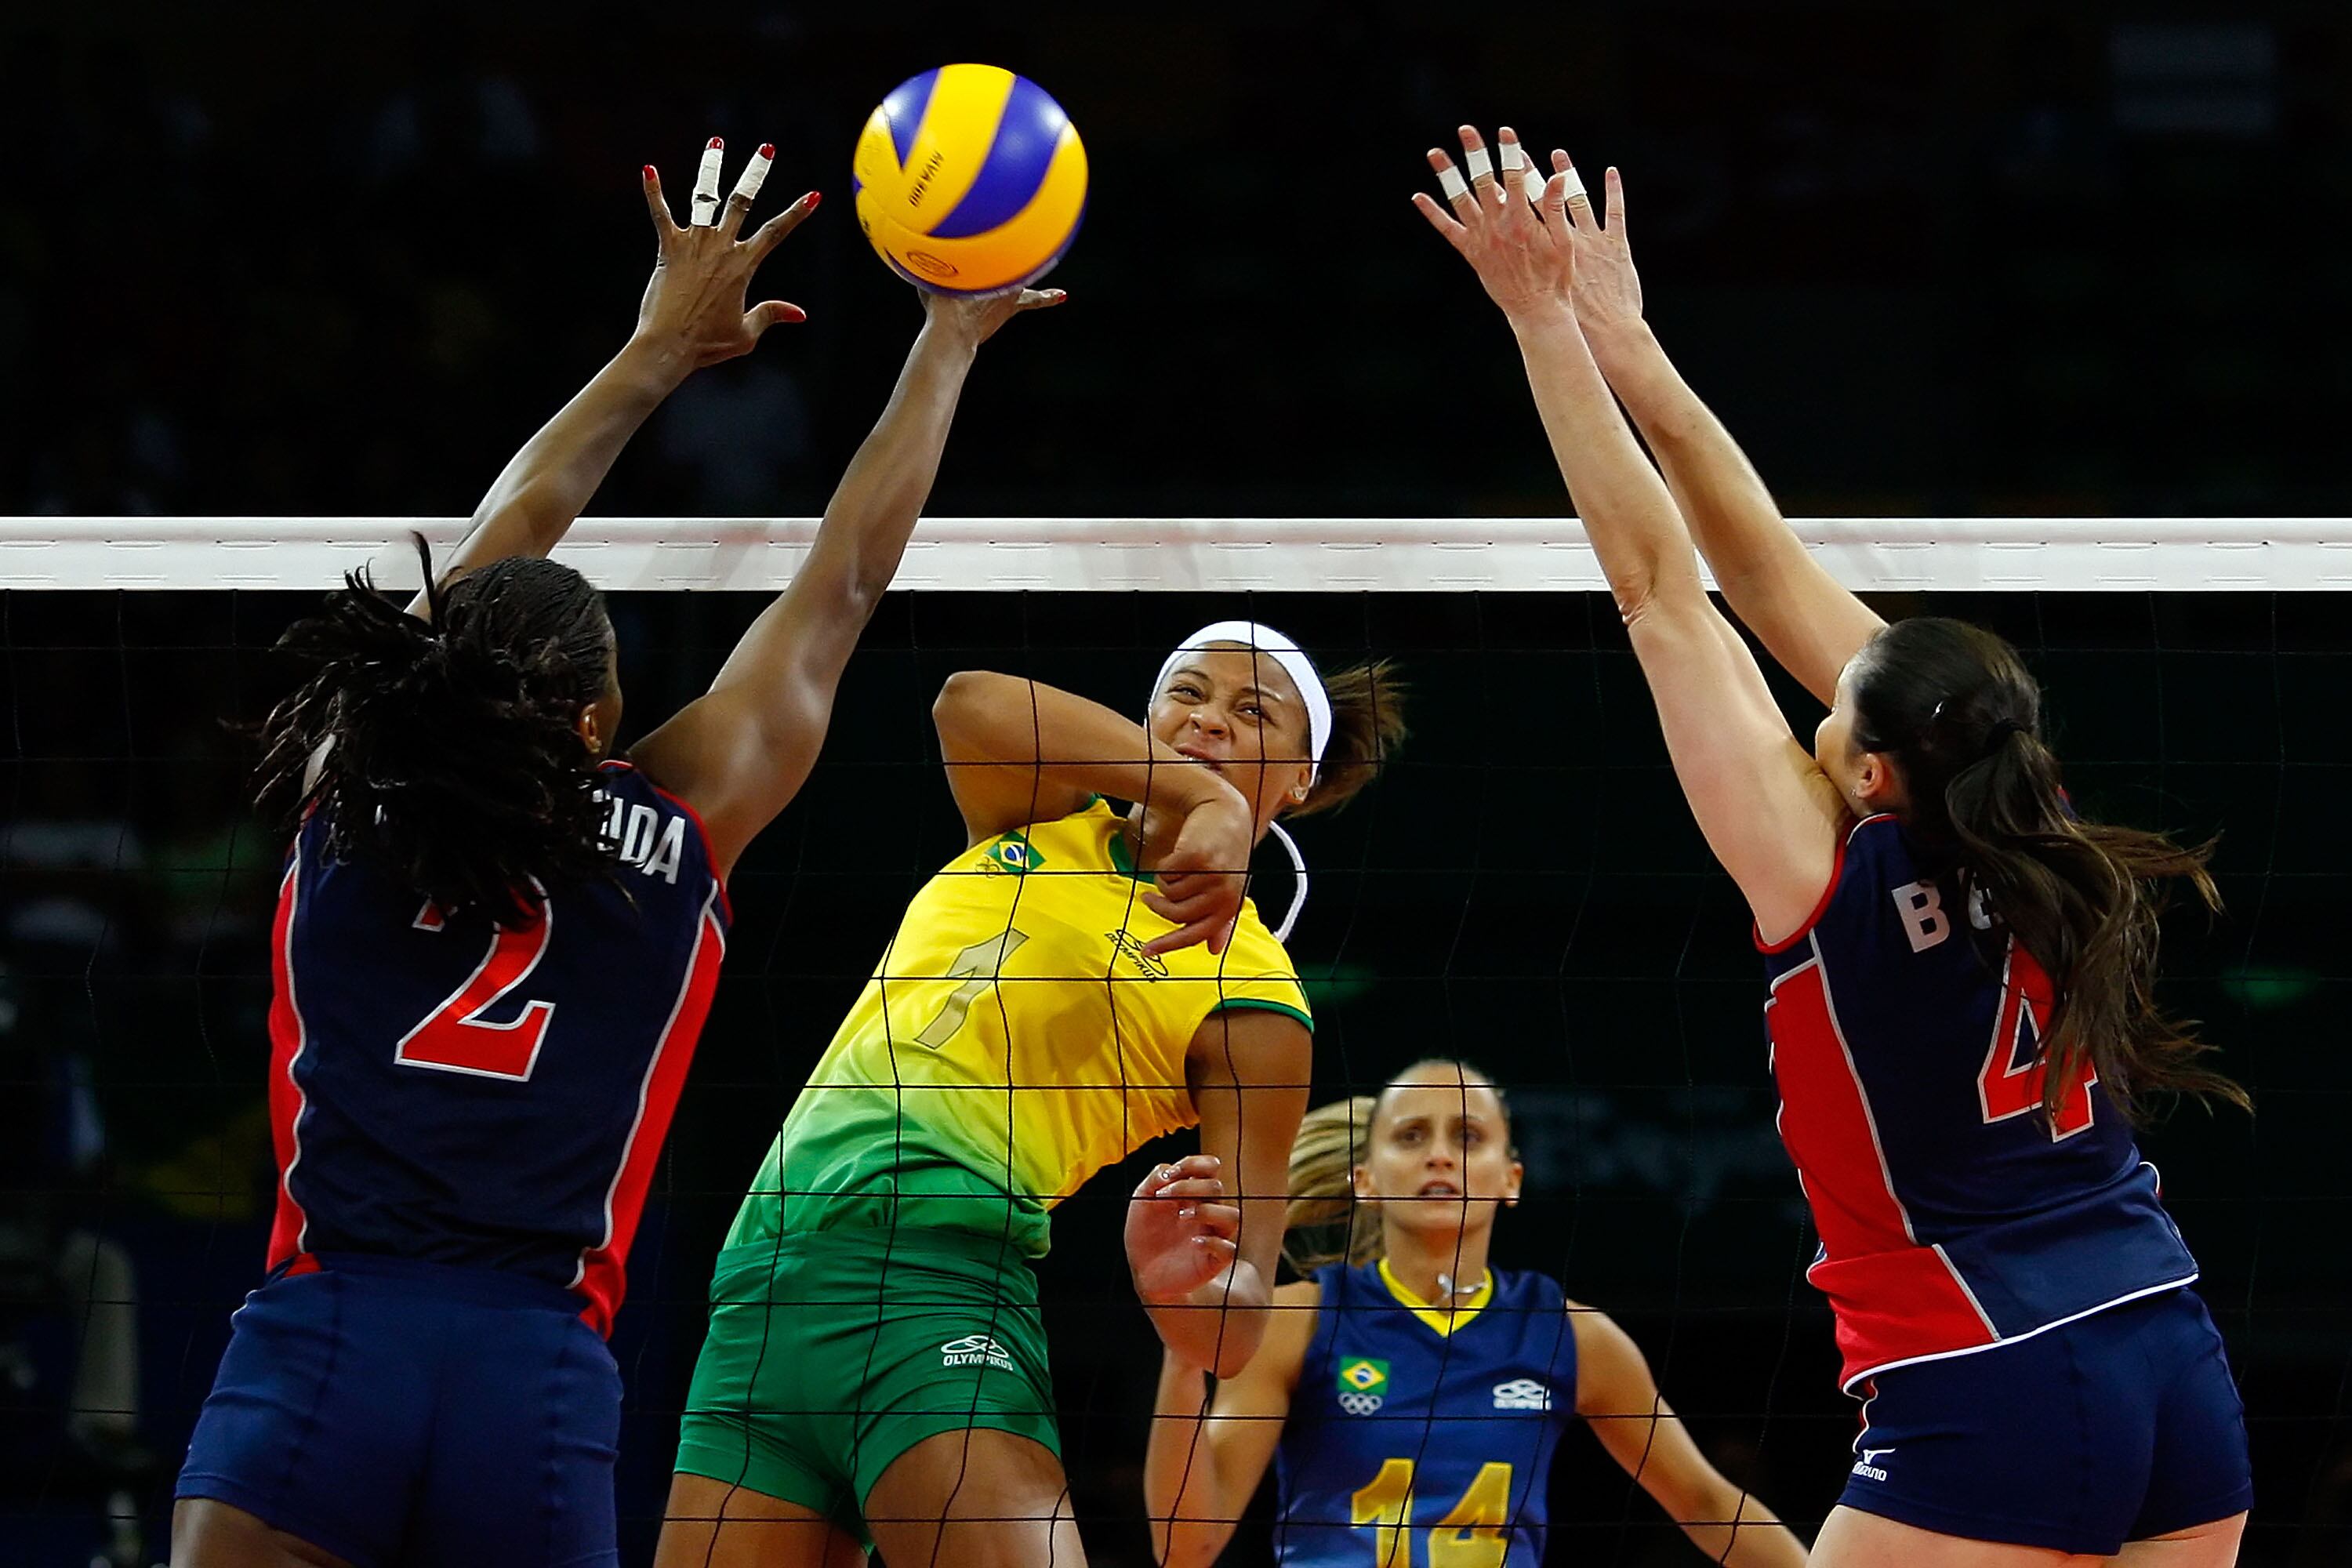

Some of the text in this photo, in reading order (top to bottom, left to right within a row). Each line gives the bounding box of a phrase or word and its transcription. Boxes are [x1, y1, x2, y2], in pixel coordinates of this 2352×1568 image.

[394, 872, 556, 1082] 2
[913, 927, 1030, 1050] 1
[1104, 933, 1156, 983] OLMPIKU
[1977, 931, 2099, 1143] 4
[1349, 1457, 1512, 1568] 14
